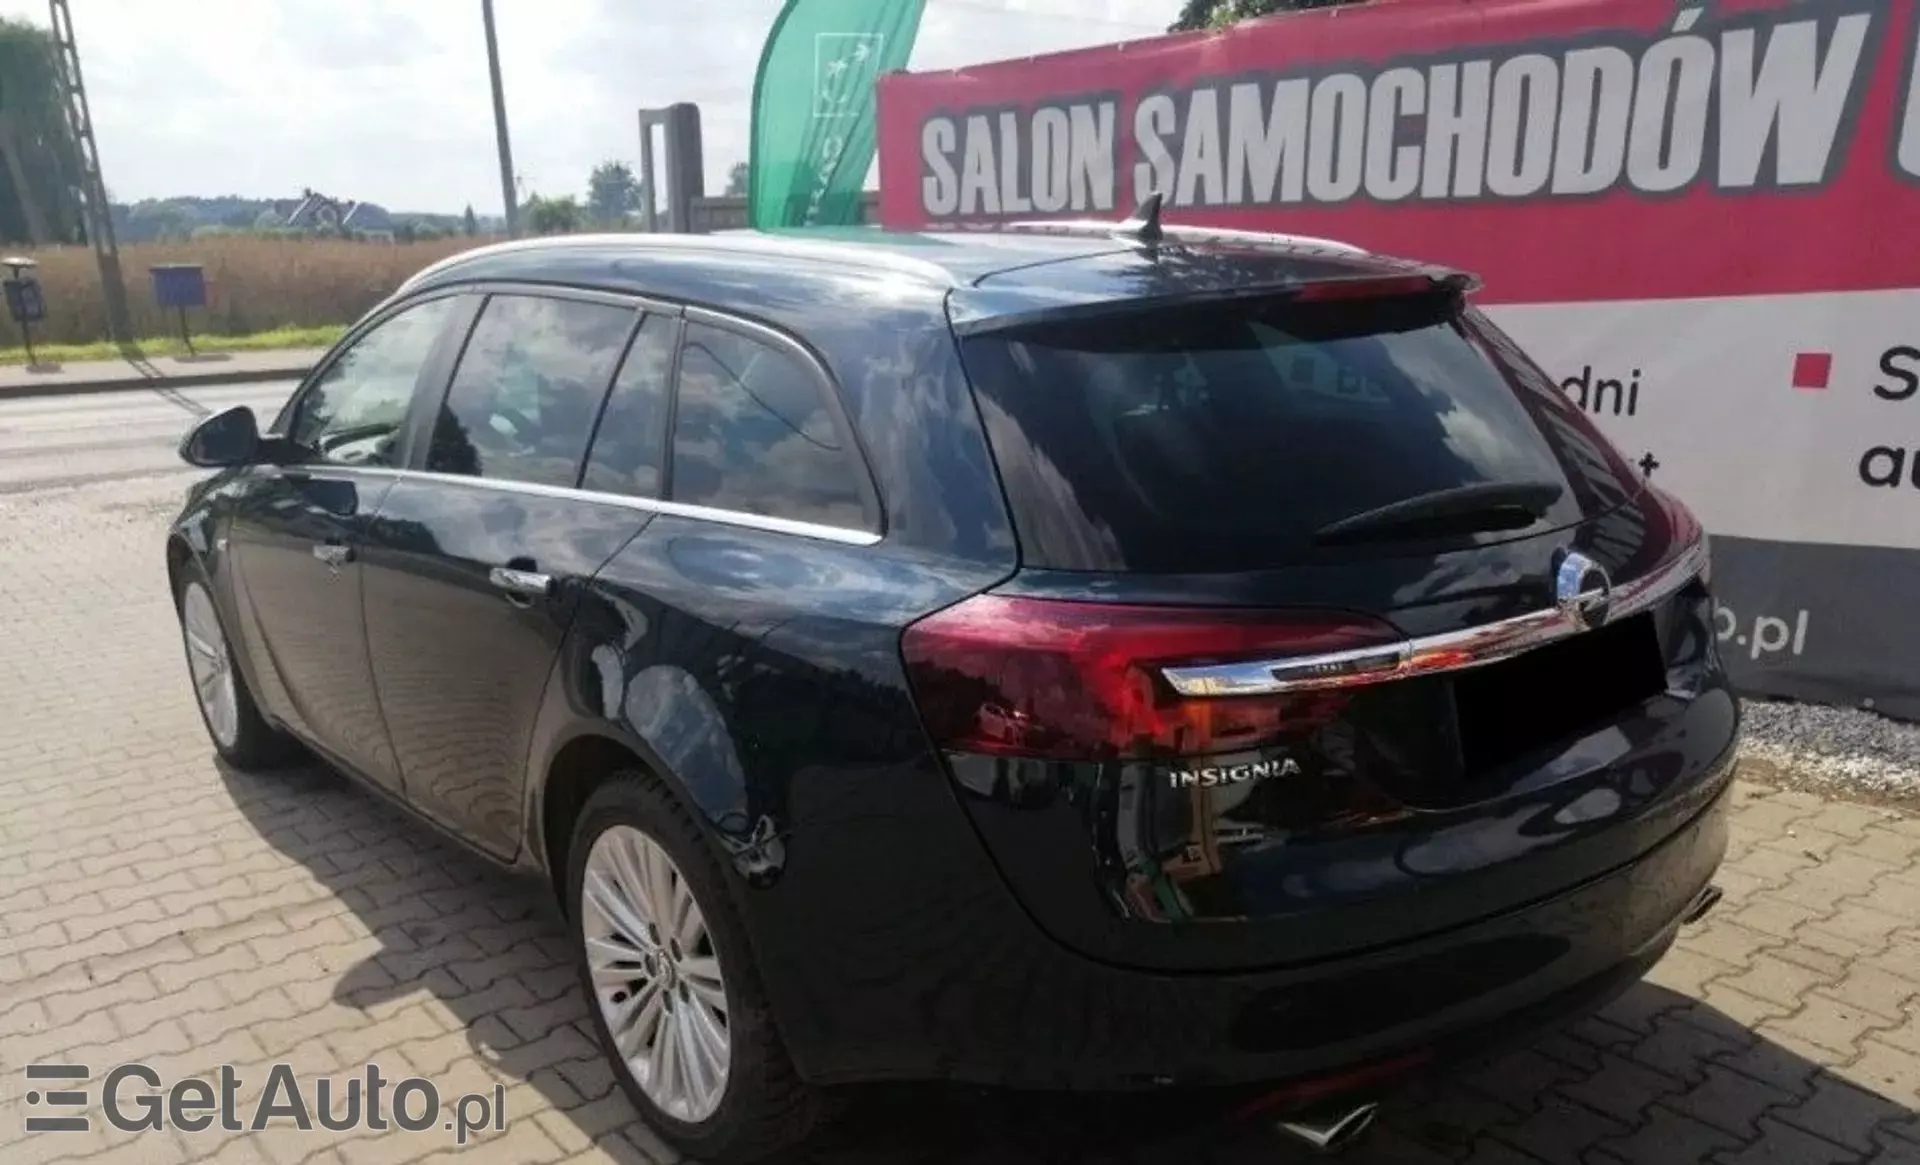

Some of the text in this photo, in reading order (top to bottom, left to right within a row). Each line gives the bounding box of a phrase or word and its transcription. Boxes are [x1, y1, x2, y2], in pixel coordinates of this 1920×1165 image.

[922, 102, 1116, 216] SALON
[1134, 9, 1871, 206] SAMOCHODÓW
[1169, 757, 1302, 788] INSIGNIA
